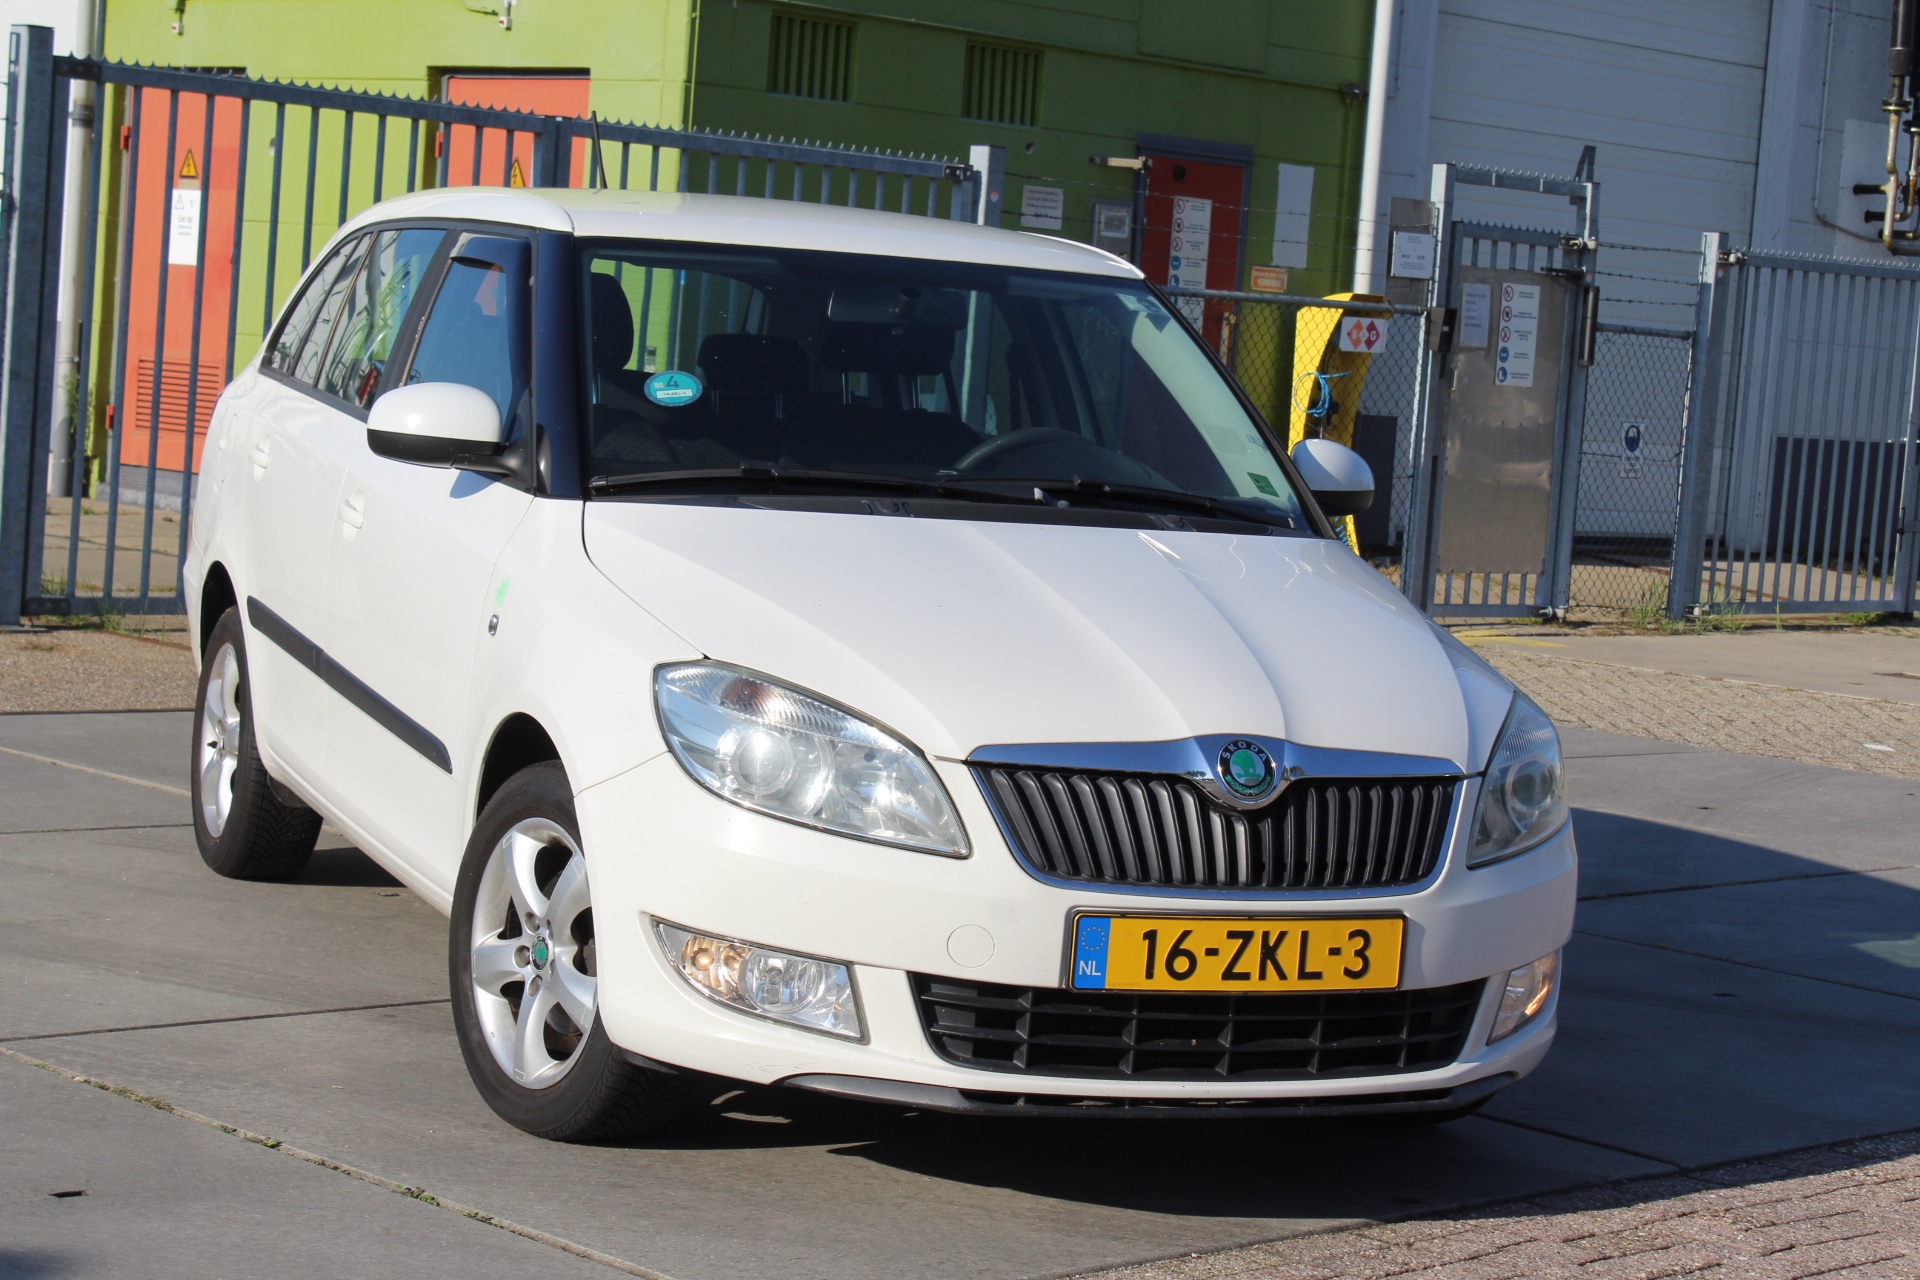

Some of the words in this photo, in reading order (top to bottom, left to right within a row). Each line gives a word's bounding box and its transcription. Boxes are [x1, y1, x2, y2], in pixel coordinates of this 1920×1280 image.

[1370, 330, 1377, 341] G
[666, 375, 680, 389] 4
[1142, 928, 1371, 981] 16-ZKL-3
[1078, 959, 1102, 977] NL
